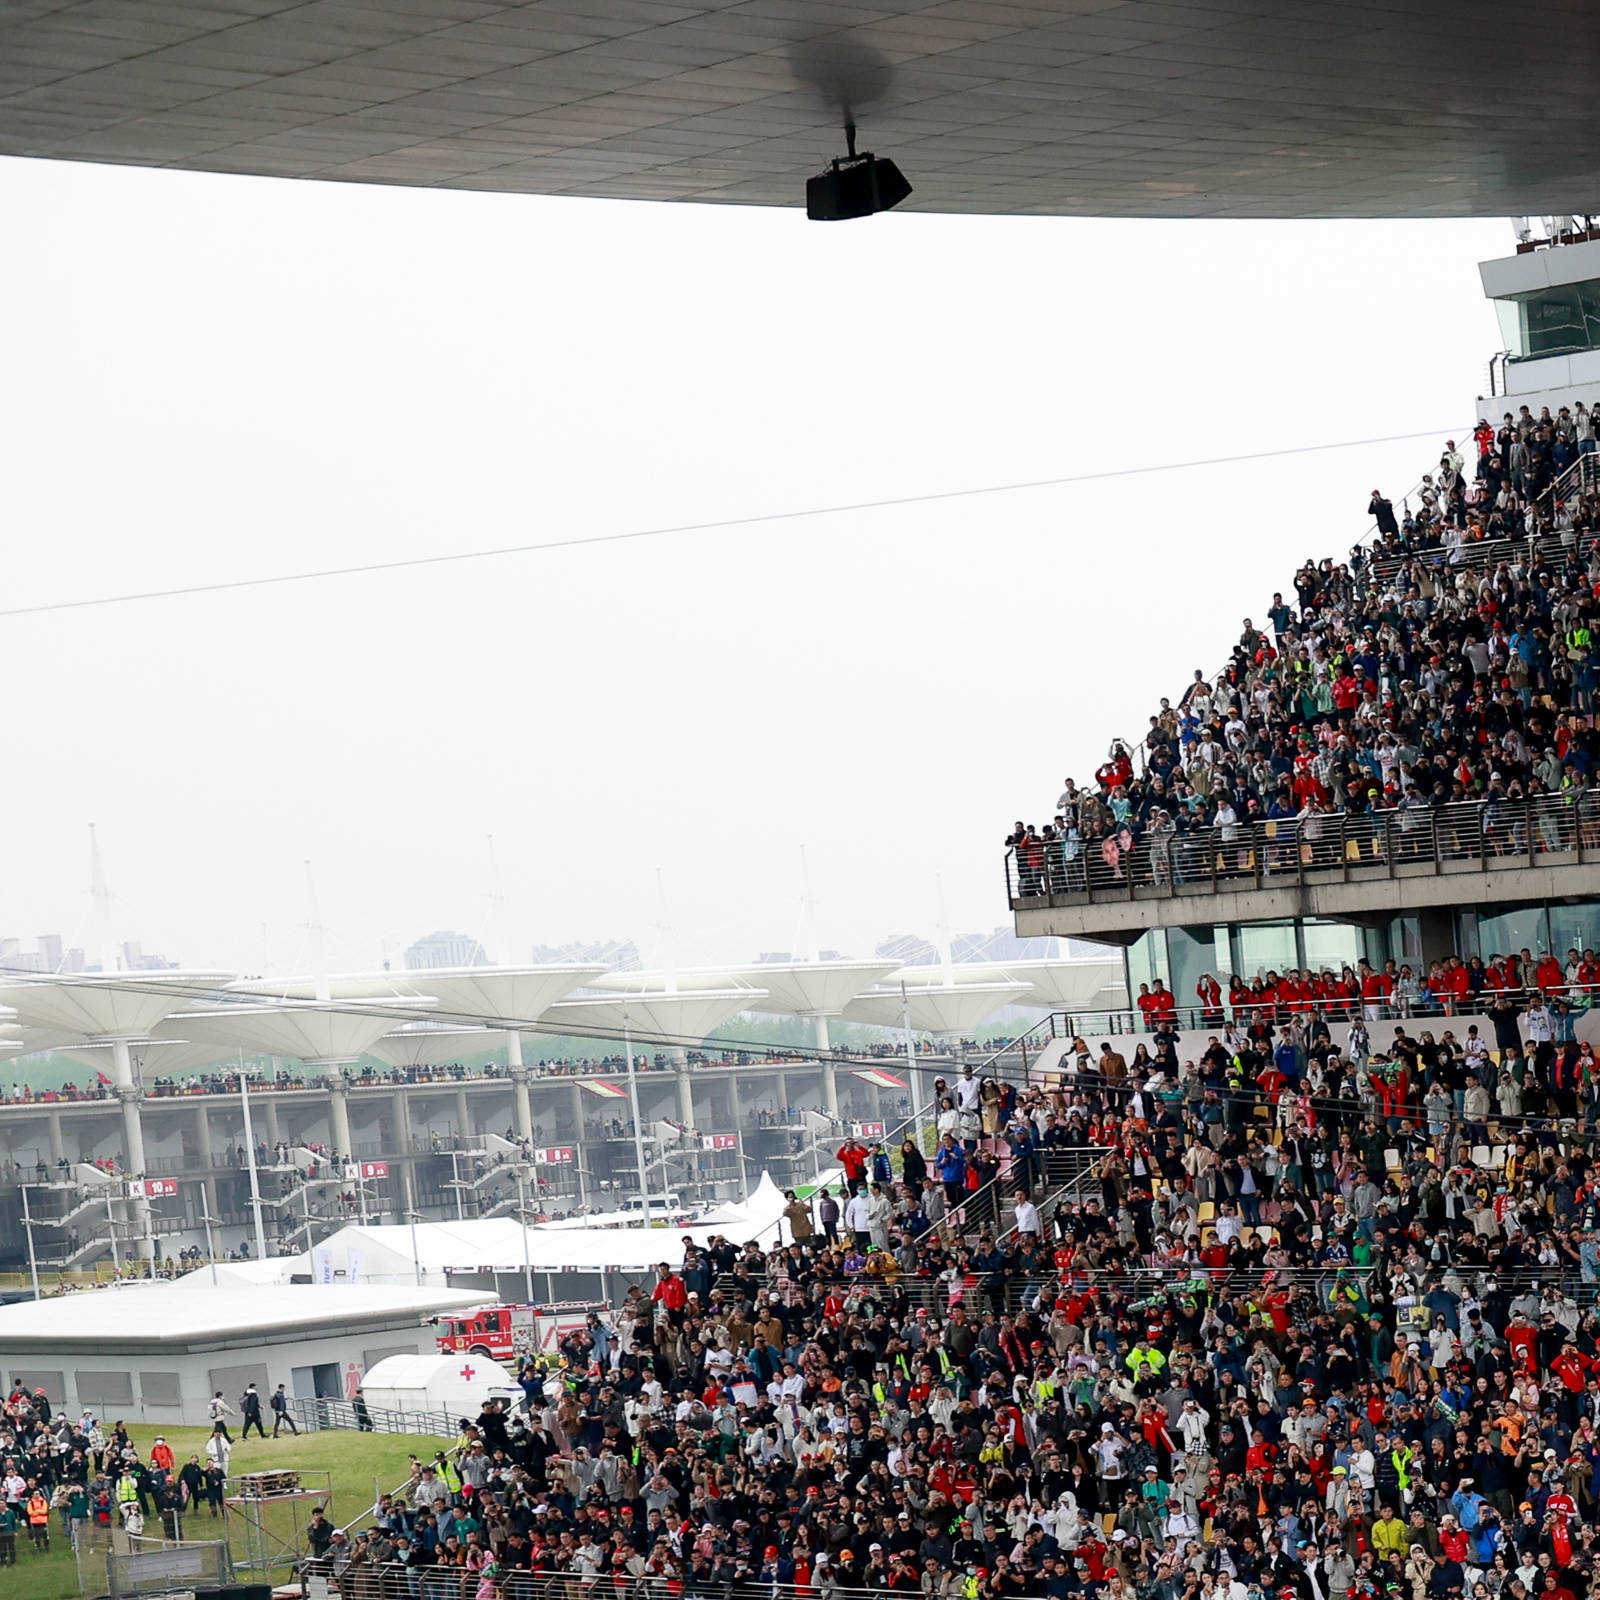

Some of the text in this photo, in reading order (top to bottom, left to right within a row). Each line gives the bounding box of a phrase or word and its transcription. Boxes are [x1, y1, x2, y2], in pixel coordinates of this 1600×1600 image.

[368, 1165, 375, 1176] 9
[133, 1182, 140, 1194] K
[152, 1181, 163, 1194] 10
